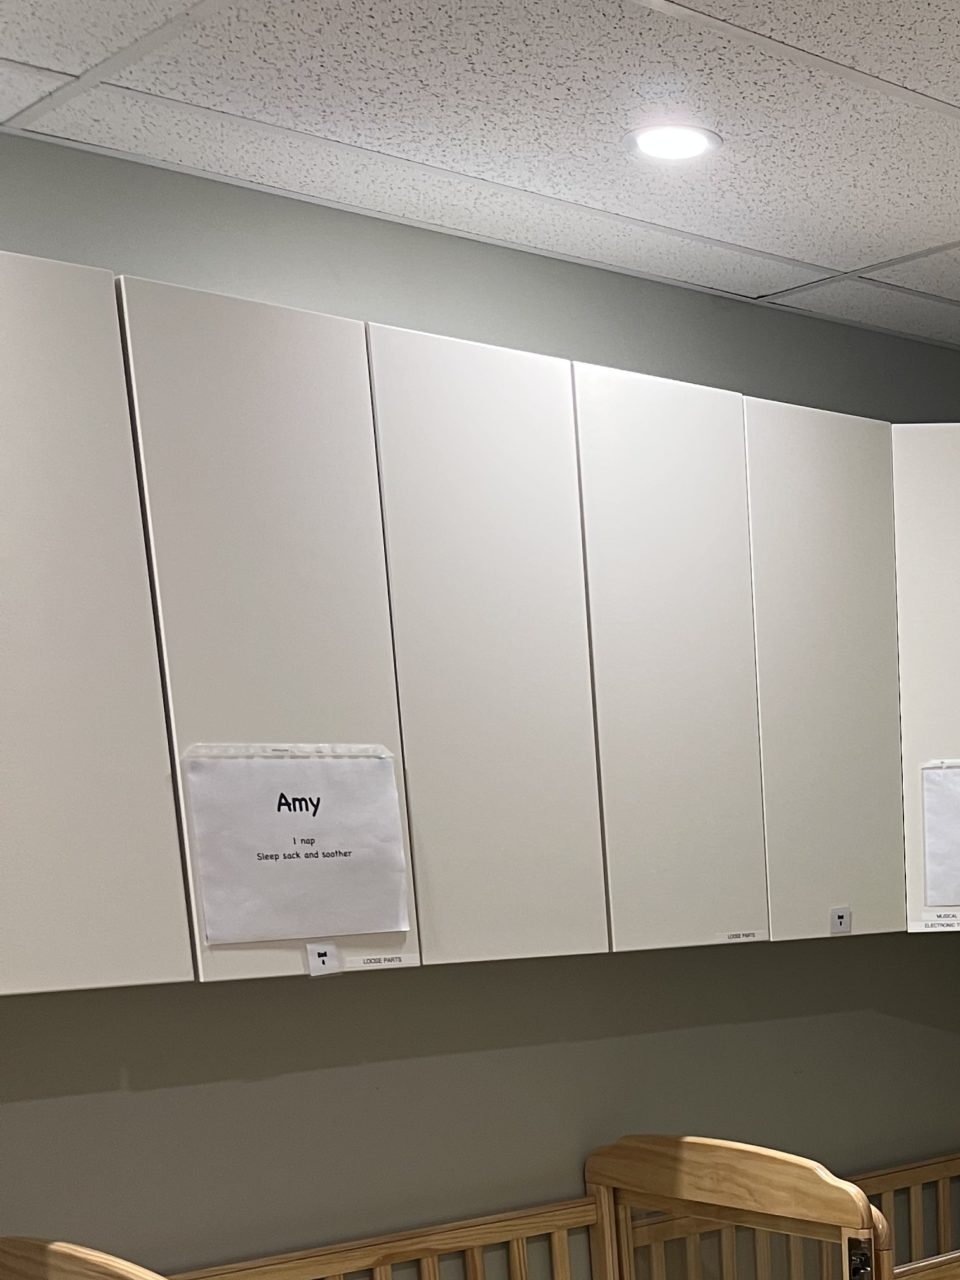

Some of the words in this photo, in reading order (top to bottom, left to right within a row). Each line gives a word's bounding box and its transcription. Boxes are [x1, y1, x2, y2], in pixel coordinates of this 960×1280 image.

[277, 793, 320, 816] Amy
[301, 838, 315, 847] nap
[257, 852, 279, 861] Sleep
[283, 851, 300, 860] sack
[305, 851, 318, 859] and
[322, 850, 352, 858] soother
